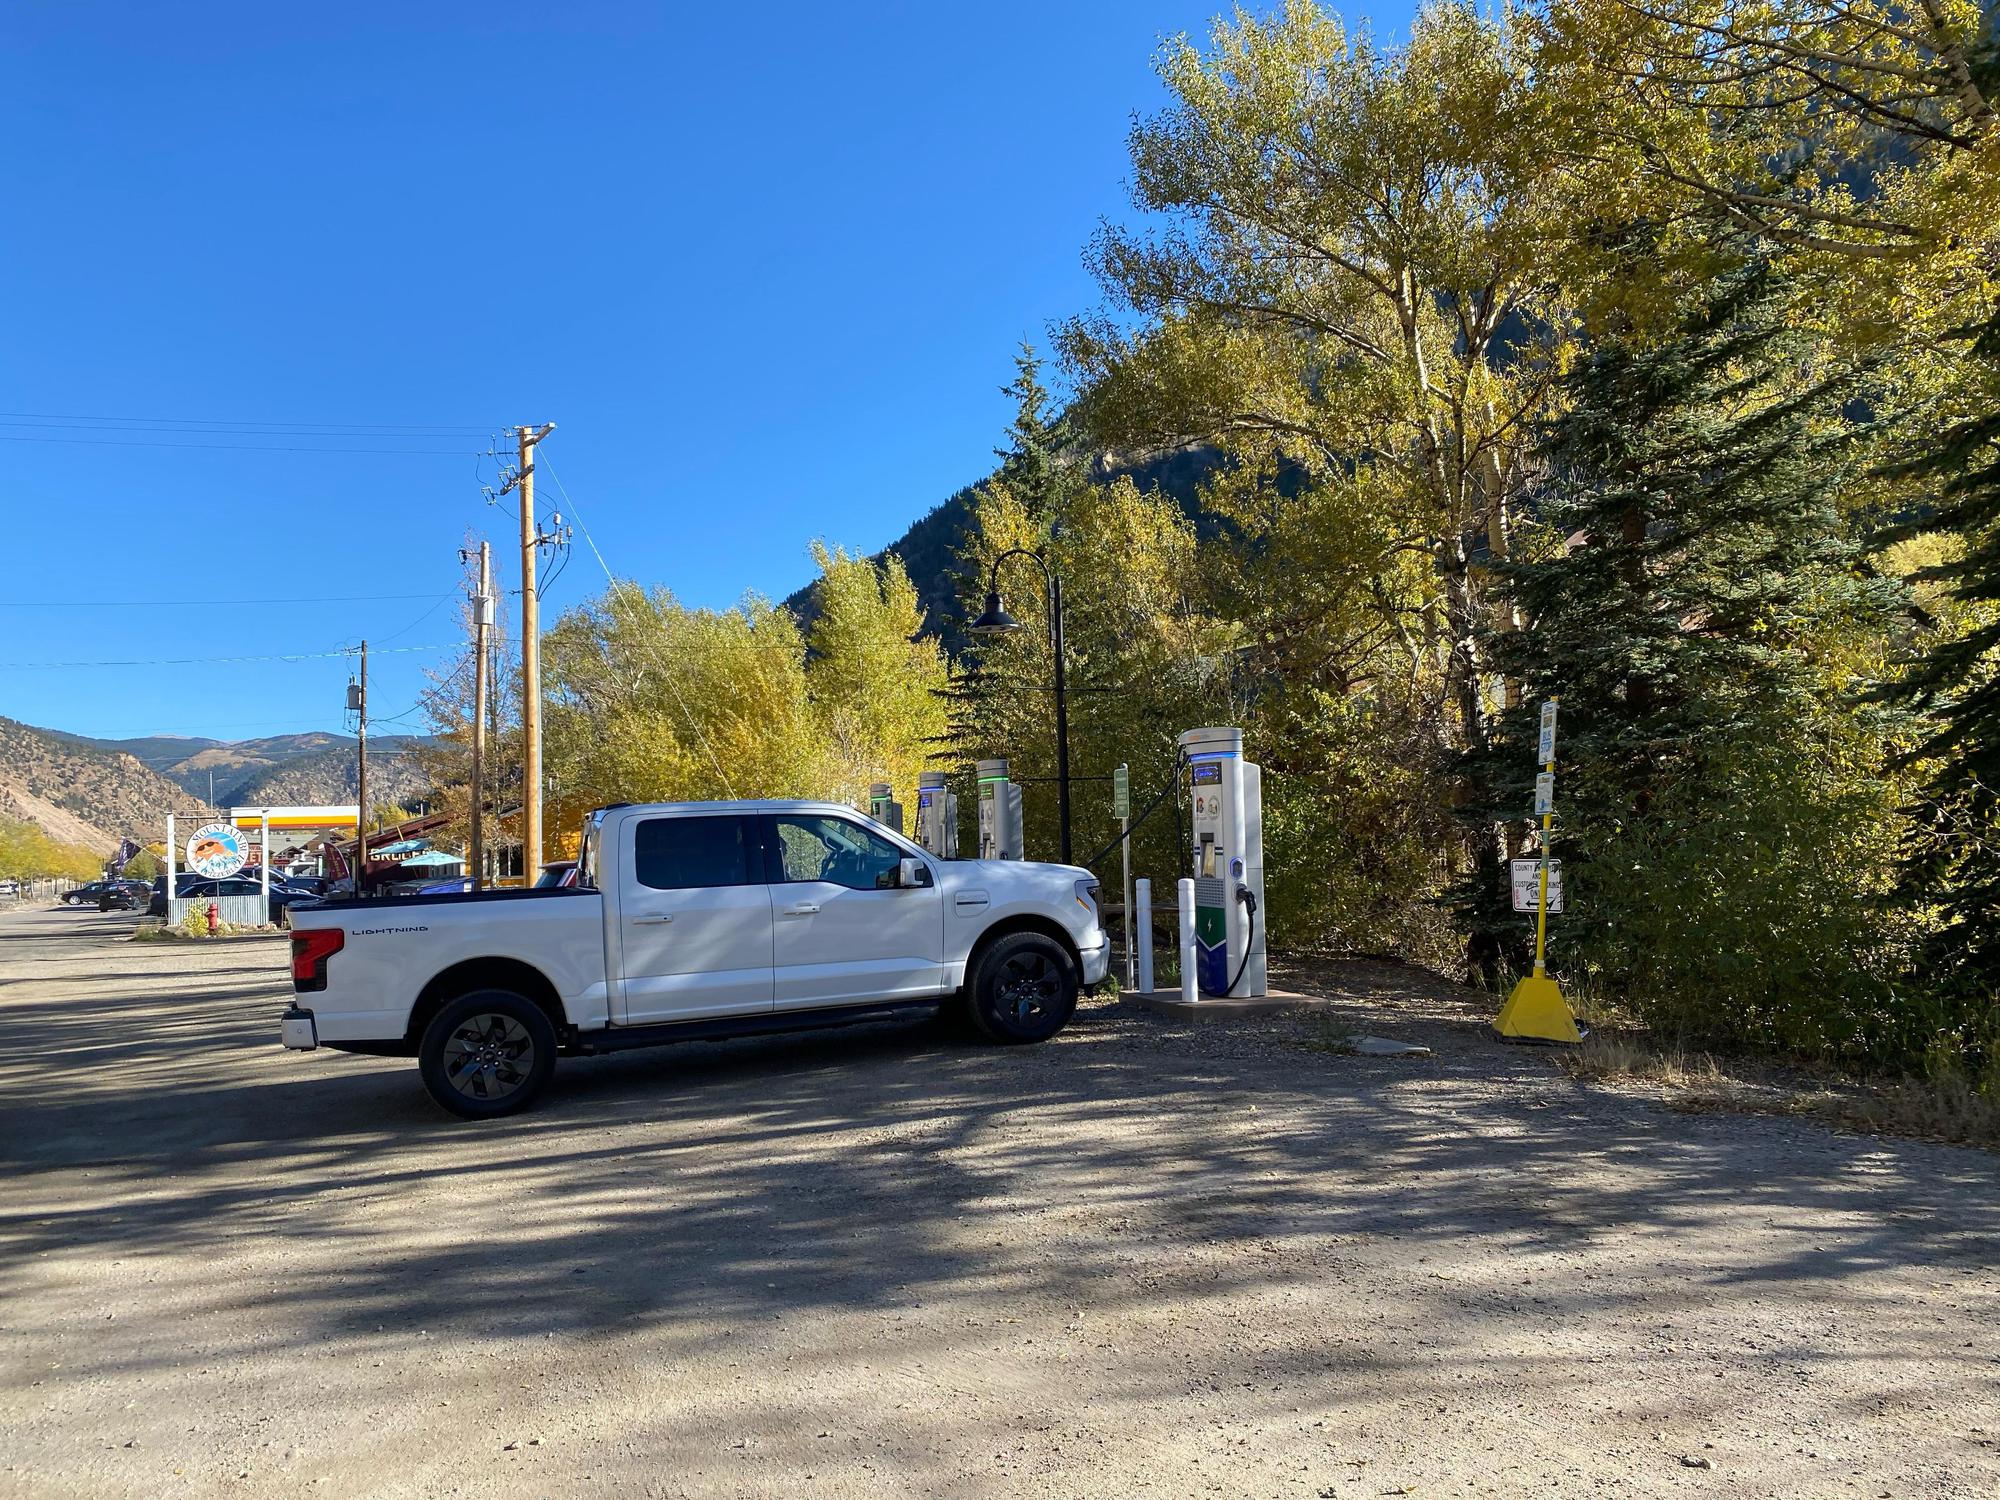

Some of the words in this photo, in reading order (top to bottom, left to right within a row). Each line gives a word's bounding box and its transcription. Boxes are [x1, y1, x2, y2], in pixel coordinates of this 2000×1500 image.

[1542, 730, 1552, 741] BUS
[1541, 741, 1552, 752] STOP
[1515, 864, 1533, 872] COUNTY
[352, 926, 429, 936] LIGHTNING
